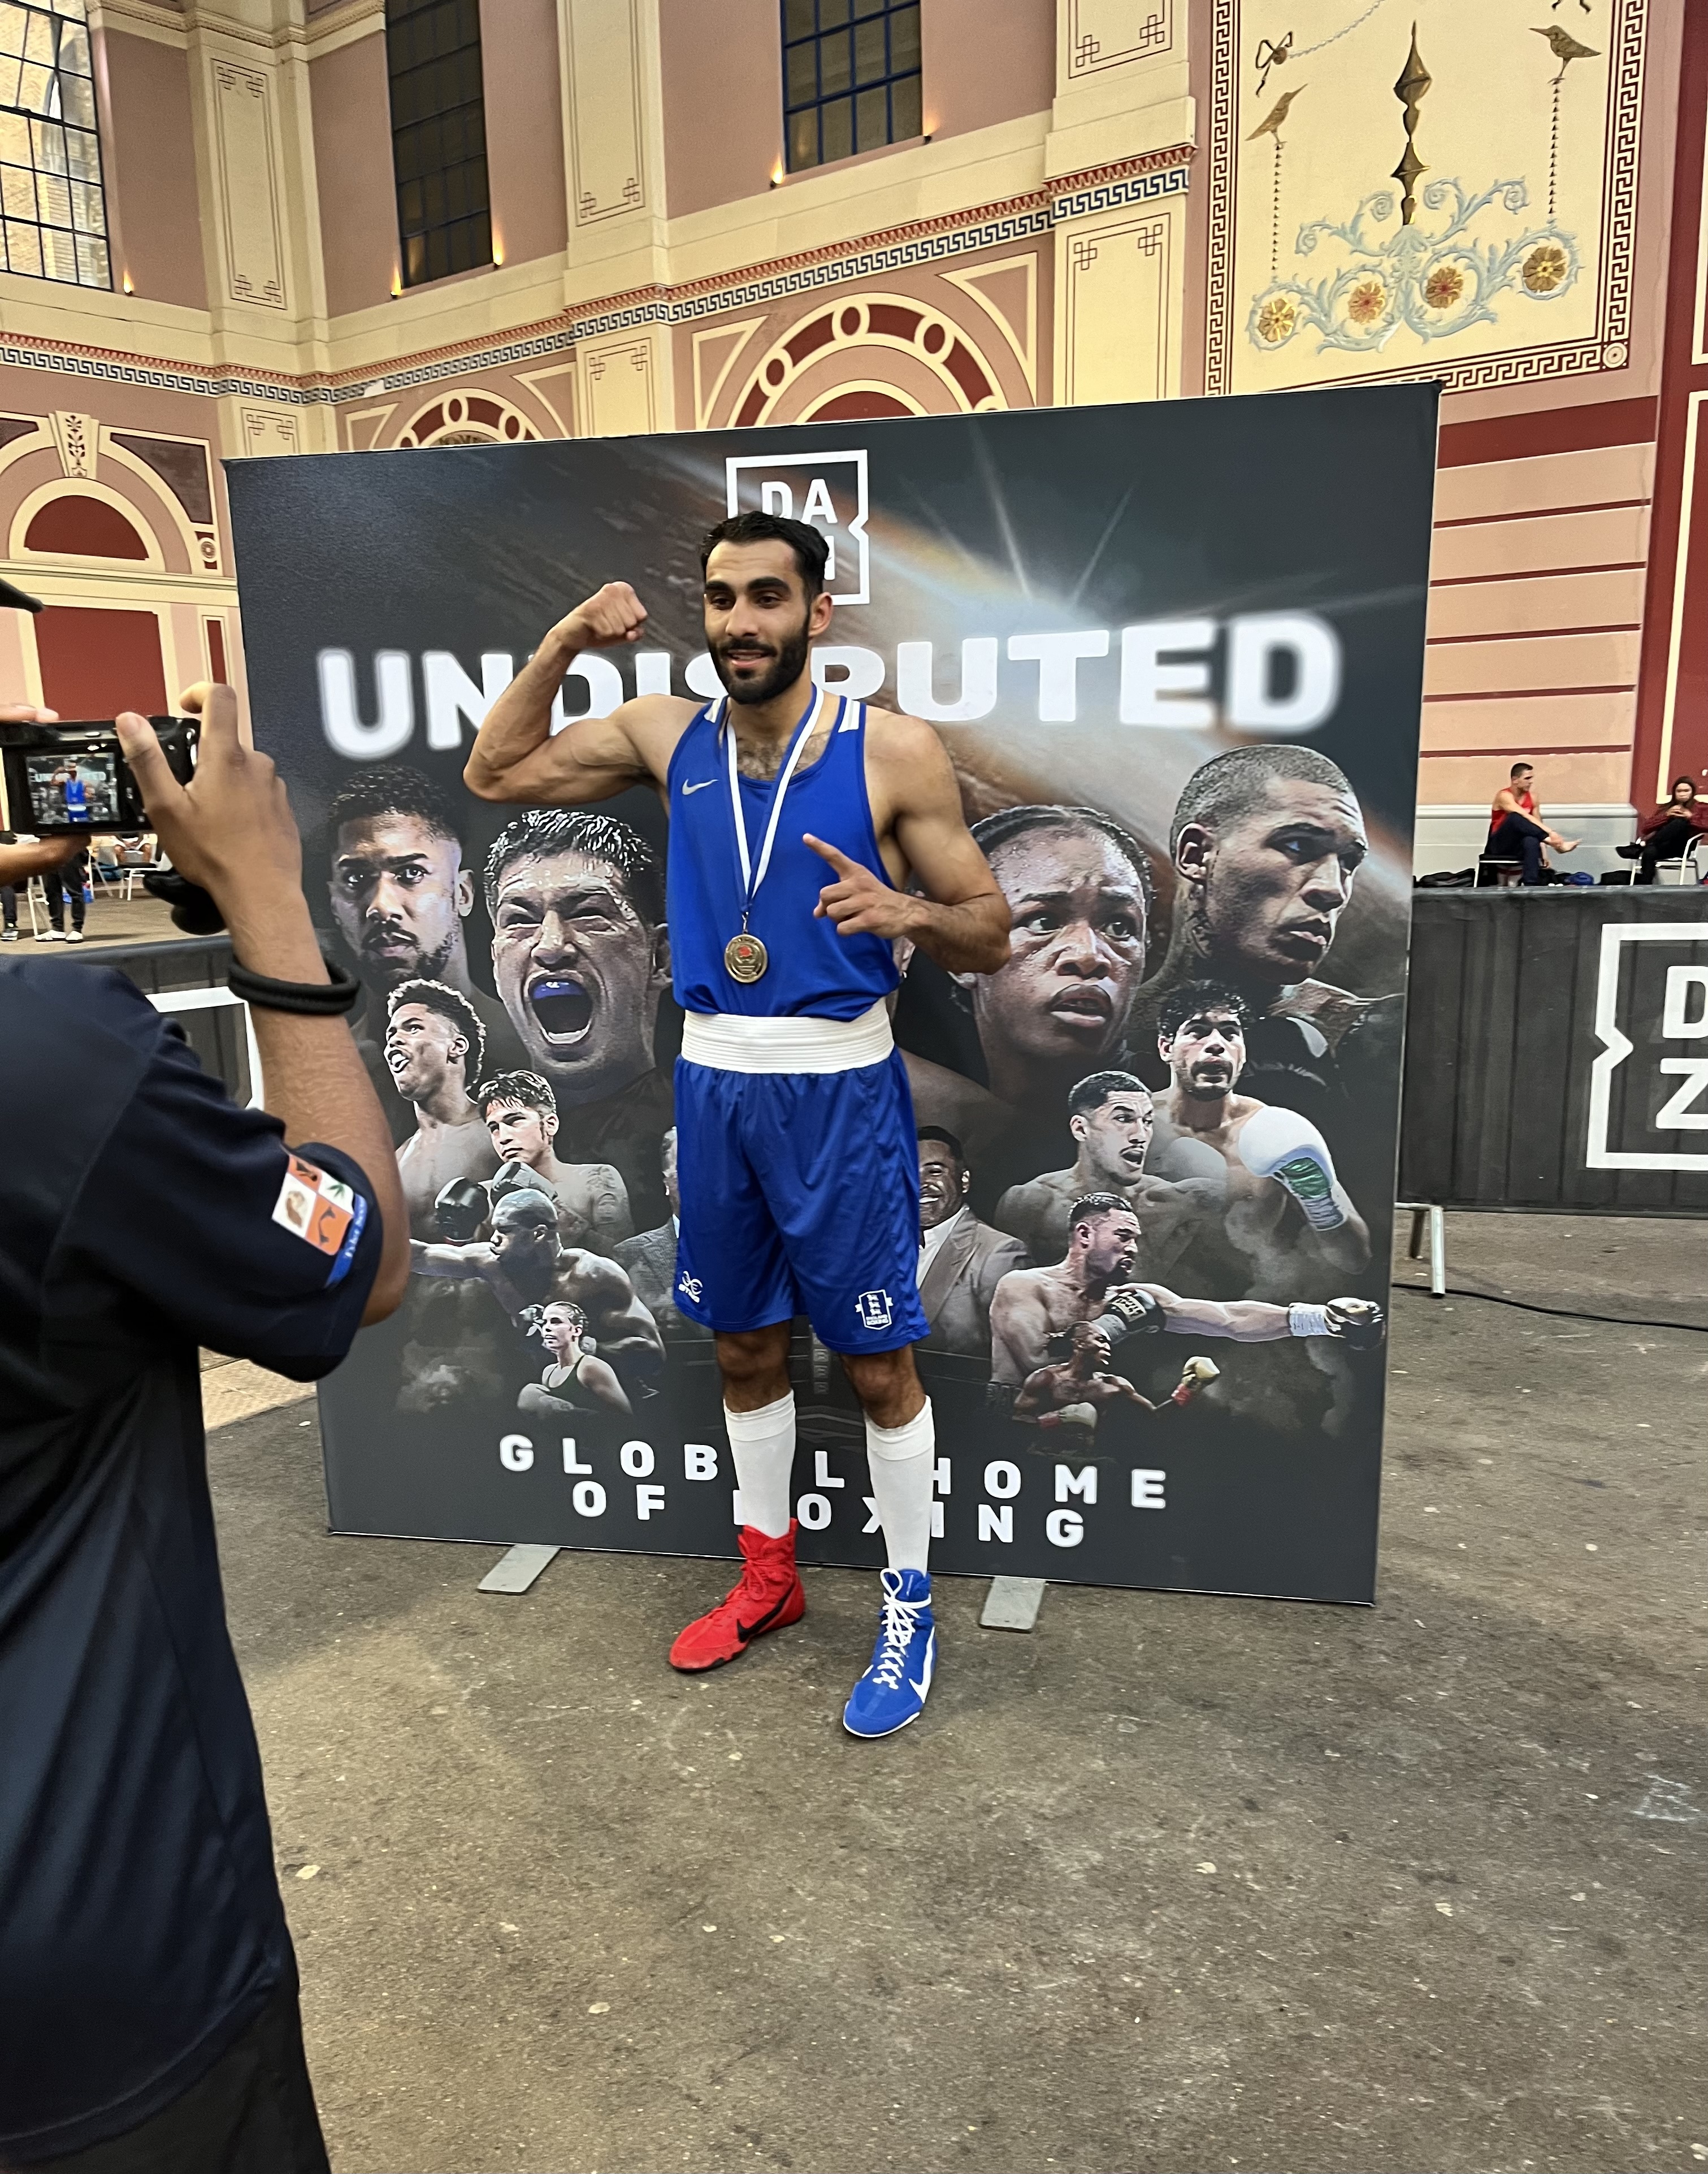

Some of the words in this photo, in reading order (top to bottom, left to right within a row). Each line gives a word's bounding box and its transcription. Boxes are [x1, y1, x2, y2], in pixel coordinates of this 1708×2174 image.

[500, 1434, 845, 1488] GLOBL
[573, 1481, 665, 1521] OF
[732, 1489, 1084, 1548] OING
